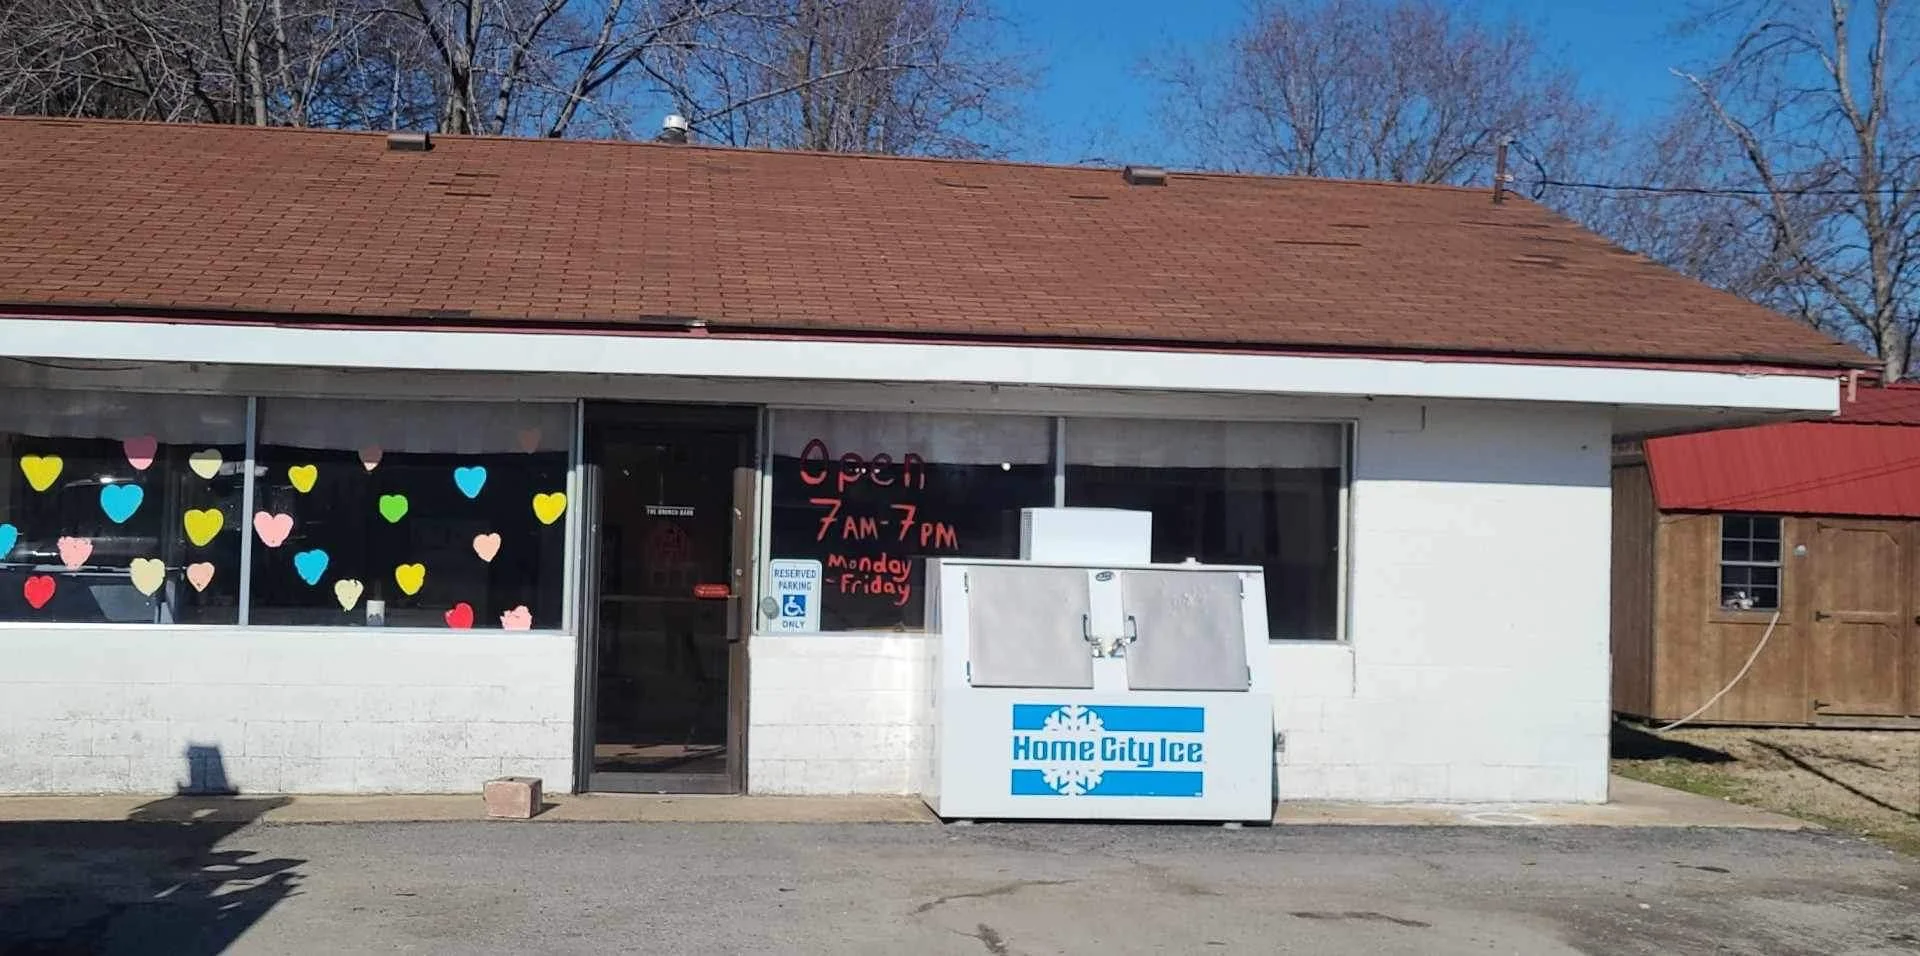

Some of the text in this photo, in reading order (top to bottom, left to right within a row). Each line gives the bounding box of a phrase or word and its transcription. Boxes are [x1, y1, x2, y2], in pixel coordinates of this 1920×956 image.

[800, 438, 925, 492] Open
[774, 569, 817, 579] RESERVED
[828, 552, 912, 582] Monday
[778, 580, 812, 591] PARKING
[782, 620, 805, 629] ONLY
[1013, 736, 1202, 767] Home City Ice
